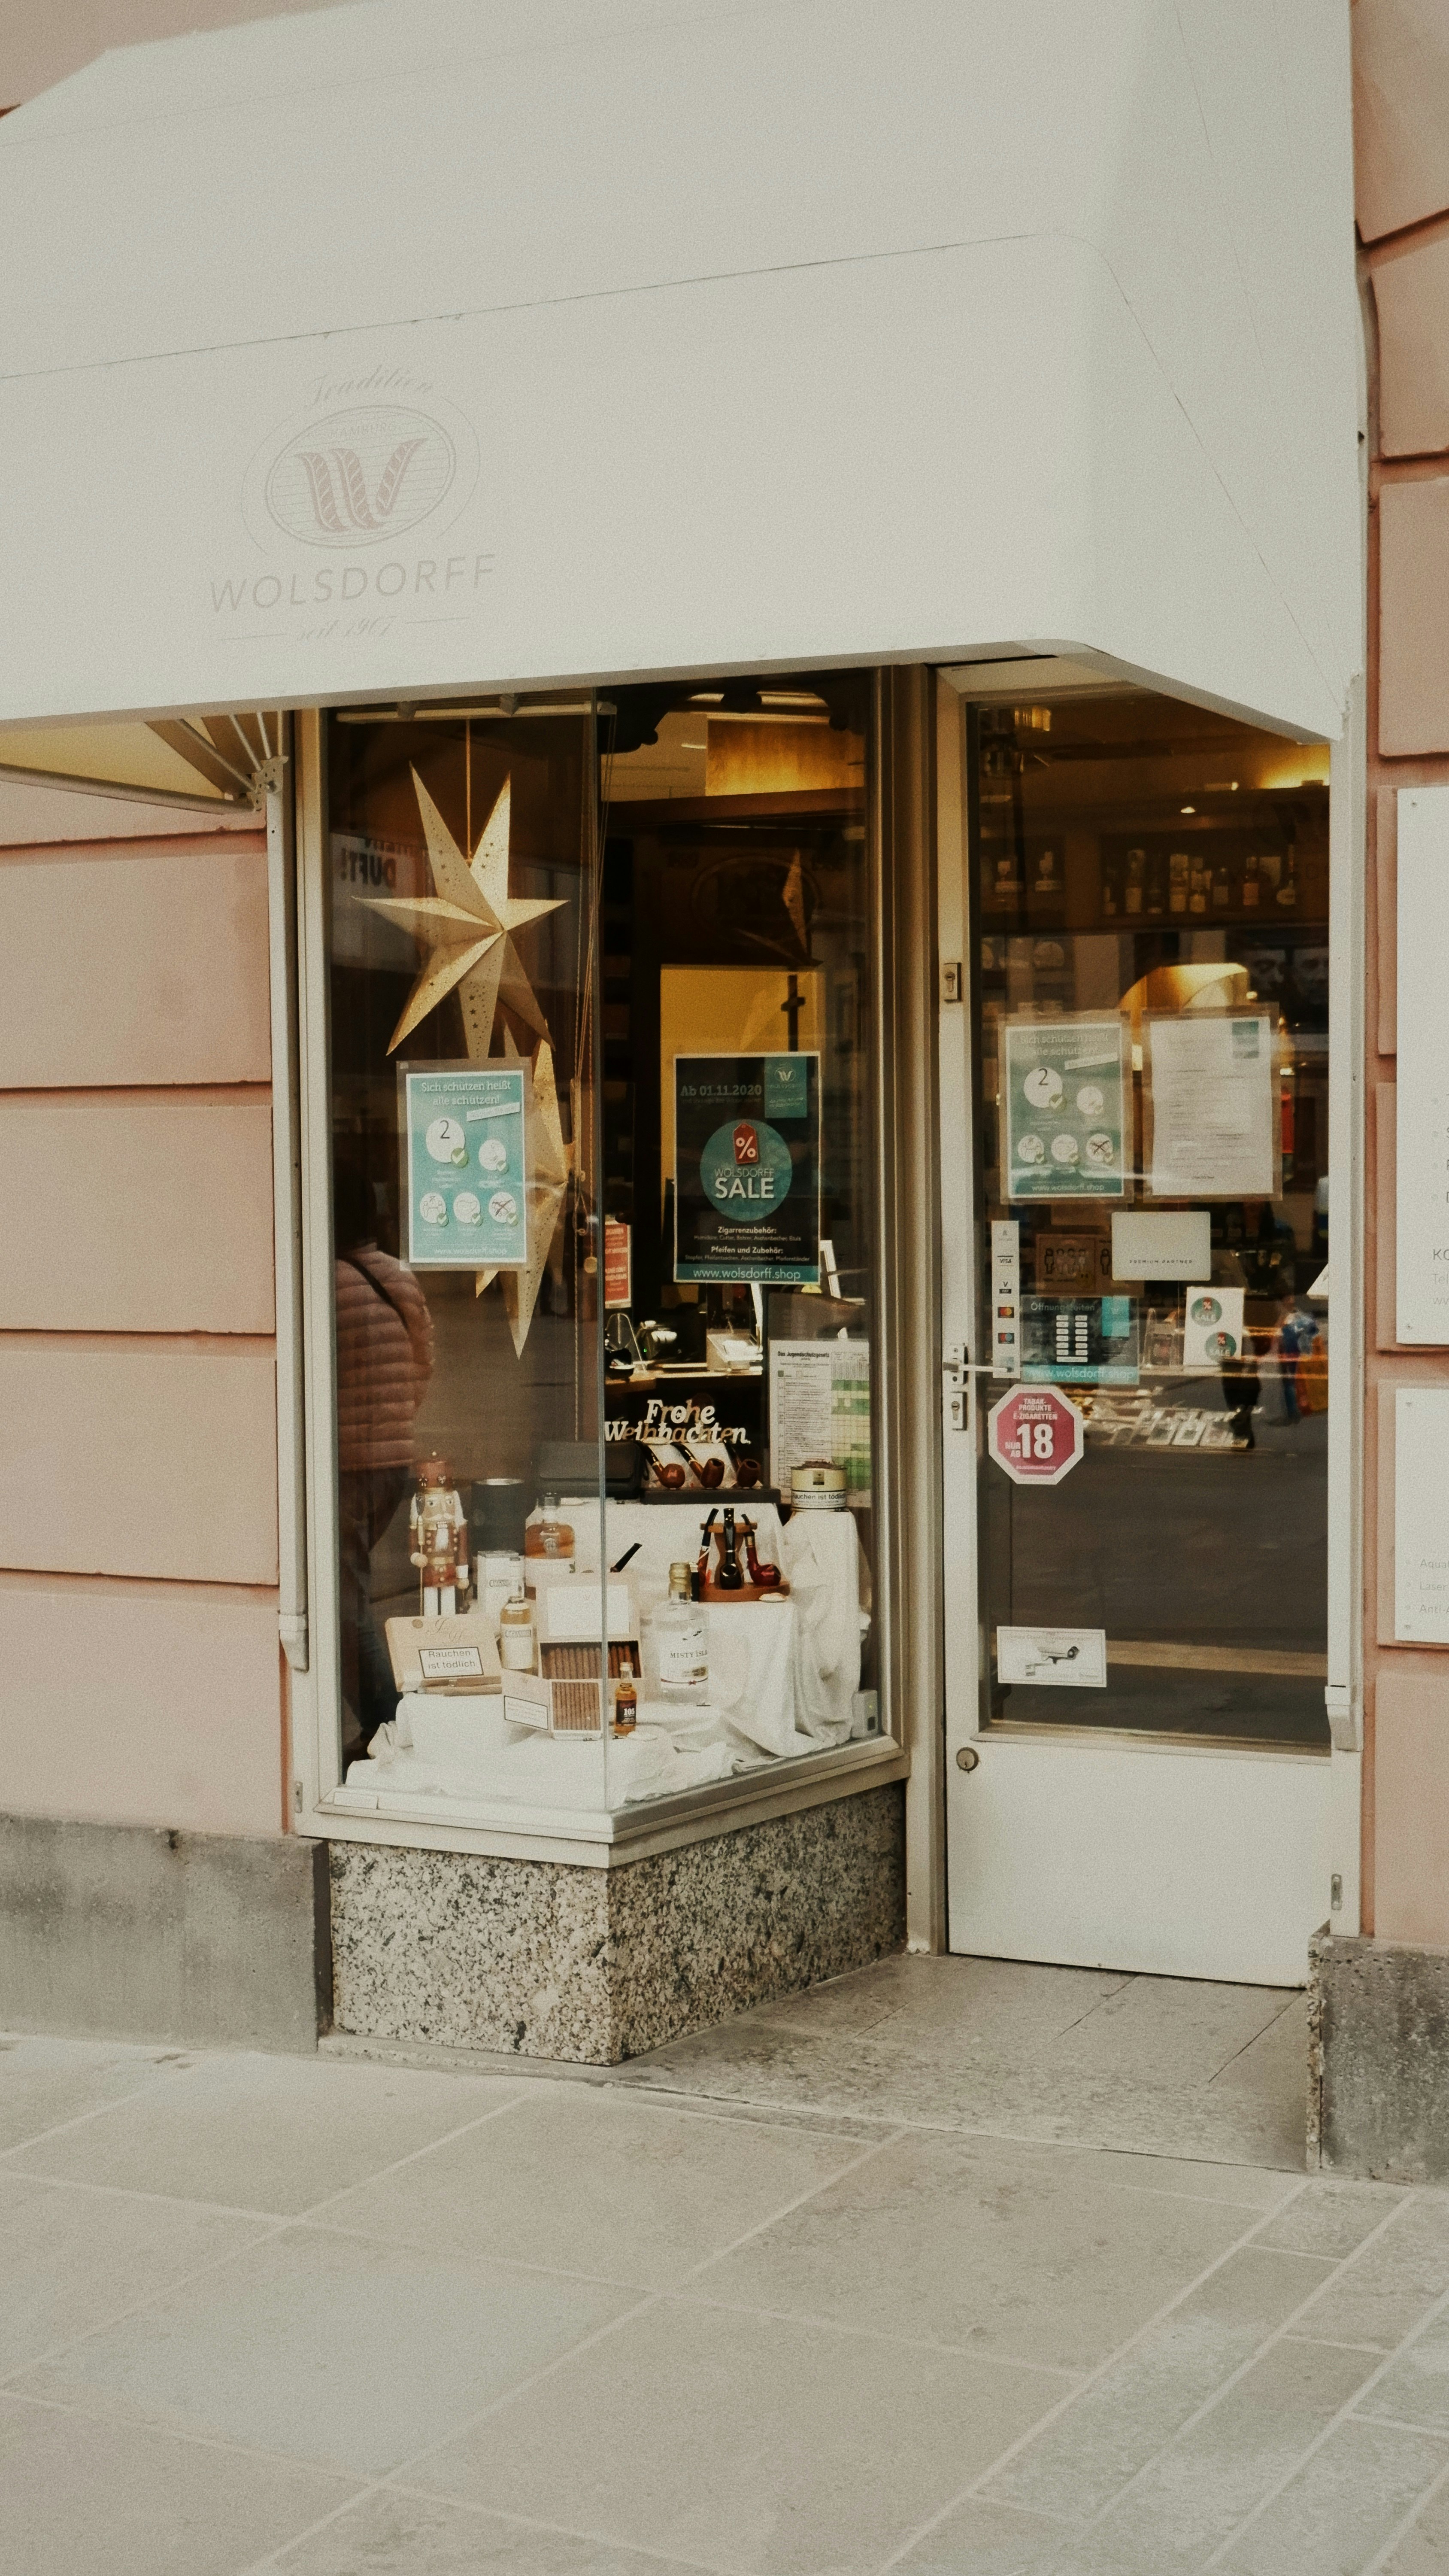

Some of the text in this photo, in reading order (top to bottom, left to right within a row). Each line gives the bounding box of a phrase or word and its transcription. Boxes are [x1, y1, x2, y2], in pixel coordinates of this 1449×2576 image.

[306, 363, 433, 408] Tradition
[209, 553, 496, 613] WOLSDORFF
[1038, 1068, 1049, 1086] 2
[421, 1082, 442, 1092] Sich
[487, 1080, 511, 1090] heißt
[680, 1084, 763, 1097] Ab 01.11.2020
[433, 1097, 449, 1106] alle
[440, 1119, 450, 1139] 2
[714, 1168, 774, 1178] WOLSDORFF
[715, 1177, 775, 1199] SALE
[717, 1226, 777, 1235] Zigarrenzubehör:
[692, 1267, 801, 1282] www.wolsdorff.shop
[1030, 1300, 1095, 1313] Öffnungszeiten
[645, 1399, 715, 1425] Frohe
[604, 1420, 747, 1444] Weihnachten
[1005, 1441, 1021, 1449] NUR
[1016, 1423, 1054, 1459] 18
[428, 1649, 471, 1658] Rauchen
[623, 1707, 636, 1716] 105
